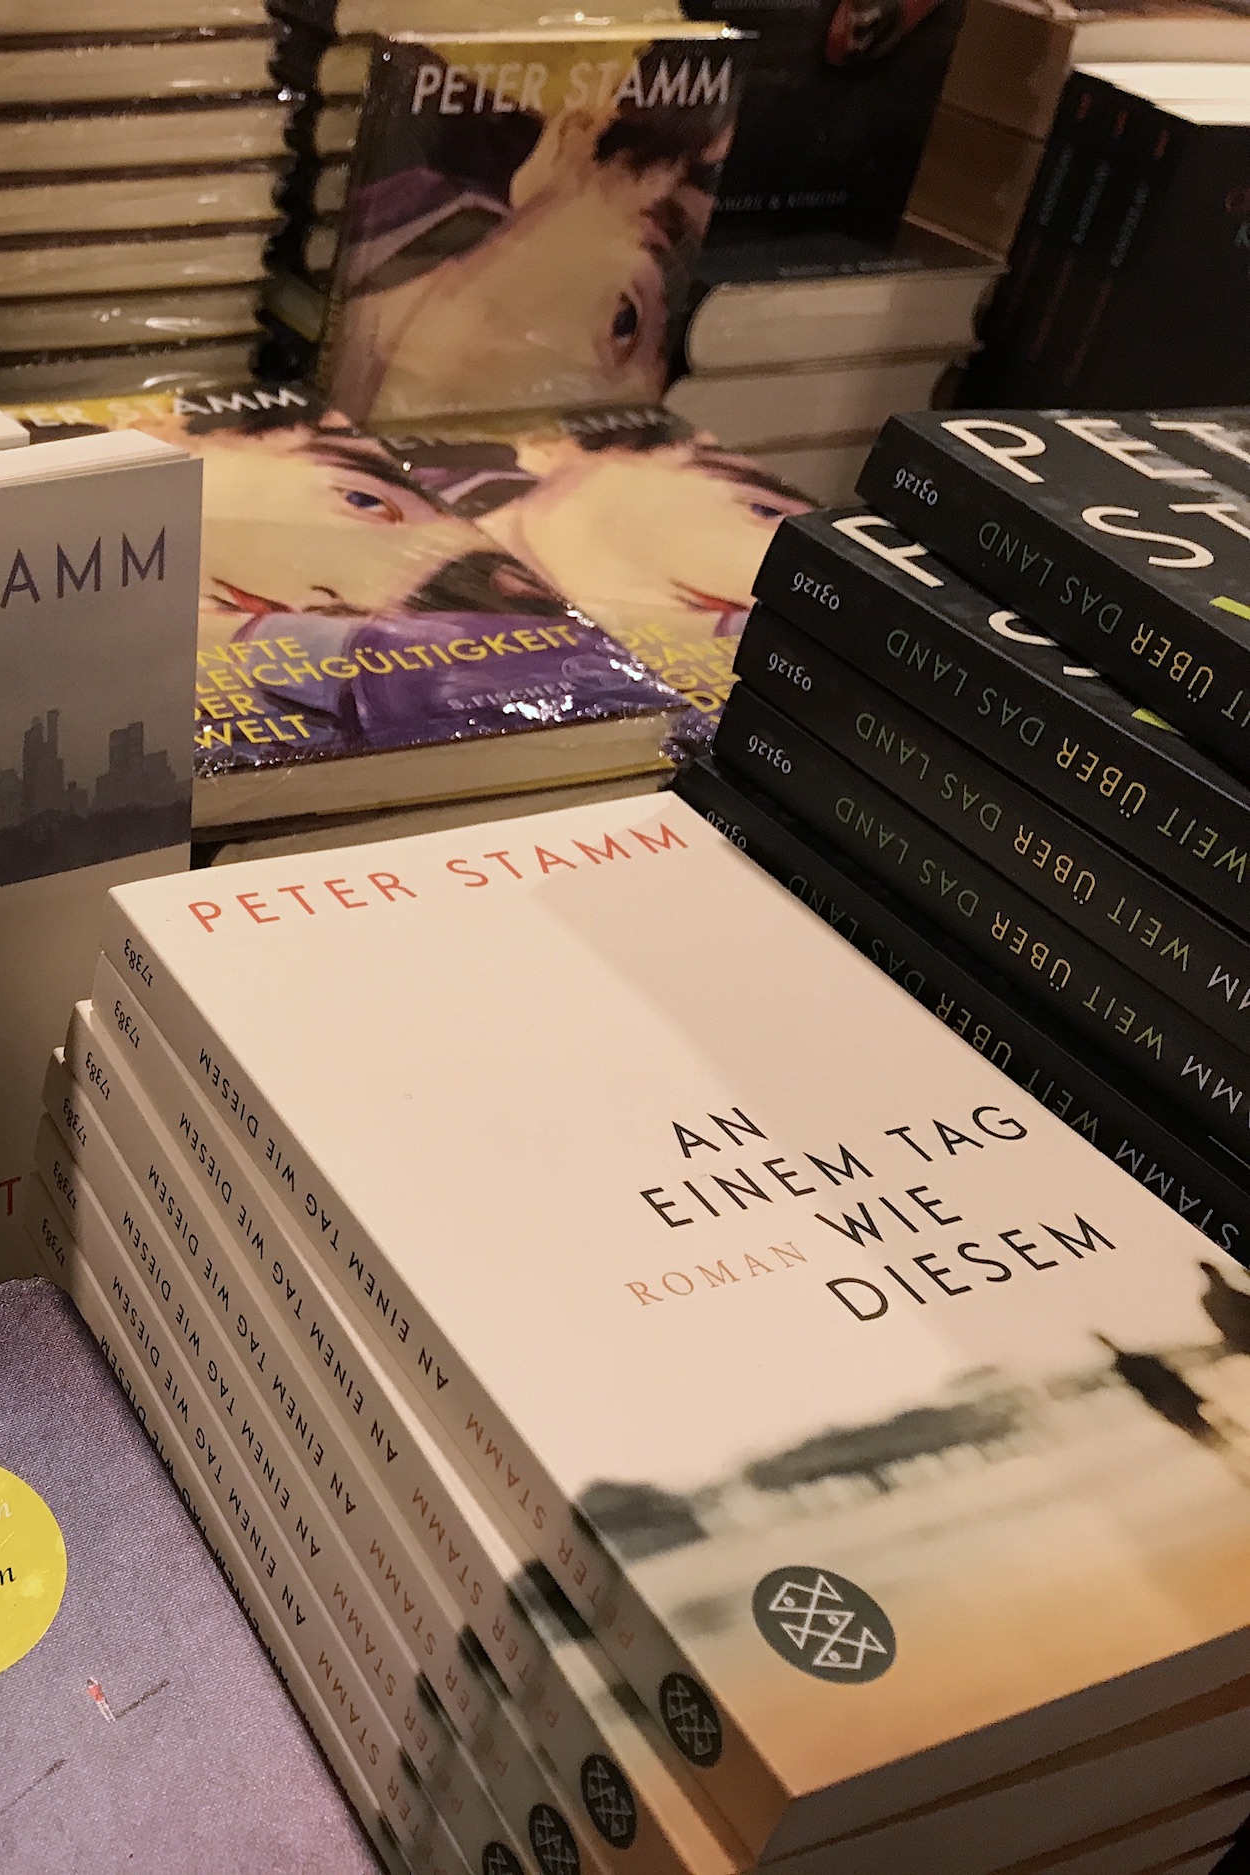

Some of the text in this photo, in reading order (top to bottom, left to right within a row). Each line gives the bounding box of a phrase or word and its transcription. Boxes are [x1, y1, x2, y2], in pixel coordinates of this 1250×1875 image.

[411, 56, 733, 115] PETER STAMM
[895, 467, 939, 507] 03126
[978, 521, 1055, 588] LAND
[793, 571, 840, 611] 03126
[1058, 577, 1124, 635] DAS
[768, 651, 811, 692] 03126
[886, 628, 969, 697] LAND
[1129, 622, 1214, 703] ÜBER
[855, 712, 931, 781] LAND
[976, 687, 1048, 747] DAS
[748, 734, 792, 775] 03126
[1056, 737, 1148, 819] ÜBER
[833, 797, 911, 865] LAND
[940, 772, 1003, 833] DAS
[188, 822, 689, 934] PETER STAMM
[1013, 824, 1097, 905] ÜBER
[1156, 806, 1248, 884] WEIT
[788, 875, 860, 943] LAND
[918, 859, 980, 918] DAS
[124, 938, 154, 988] 17383
[870, 938, 927, 998] DAS
[991, 911, 1071, 992] ÜBER
[1106, 896, 1192, 973] WEIT
[114, 999, 141, 1051] 17383
[1082, 985, 1165, 1061] WEIT
[85, 1051, 111, 1101] 17383
[199, 1047, 260, 1139] DIESEM
[1022, 1068, 1099, 1142] WEIT
[179, 1111, 232, 1205] DIESEM
[266, 1138, 296, 1193] WIE
[670, 1106, 768, 1159] AN
[639, 1105, 1028, 1228] EINEM TAG
[1113, 1140, 1240, 1251] STAMM
[148, 1164, 200, 1257] DIESEM
[237, 1204, 265, 1261] WIE
[304, 1193, 339, 1252] TAG
[813, 1185, 963, 1248] WIE
[122, 1210, 171, 1302] DIESEM
[203, 1258, 230, 1312] WIE
[624, 1240, 808, 1307] ROMAN
[824, 1213, 1117, 1322] DIESEM
[112, 1275, 161, 1369] DIESEM
[271, 1260, 302, 1320] TAG
[348, 1251, 410, 1343] EINEM
[175, 1303, 200, 1358] WIE
[237, 1314, 266, 1374] TAG
[164, 1369, 189, 1424] WIE
[207, 1360, 235, 1417] TAG
[309, 1321, 364, 1415] EINEM
[418, 1347, 449, 1391] AN
[271, 1374, 325, 1467] EINEM
[370, 1420, 398, 1464] AN
[194, 1427, 222, 1484] TAG
[241, 1419, 291, 1512] EINEM
[465, 1412, 547, 1531] STAMM
[330, 1471, 357, 1516] AN
[228, 1487, 277, 1579] EINEM
[296, 1516, 321, 1559] AN
[412, 1486, 484, 1606] STAMM
[281, 1584, 307, 1627] AN
[369, 1538, 437, 1656] STAMM
[333, 1582, 397, 1697] STAMM
[317, 1650, 379, 1766] STAMM
